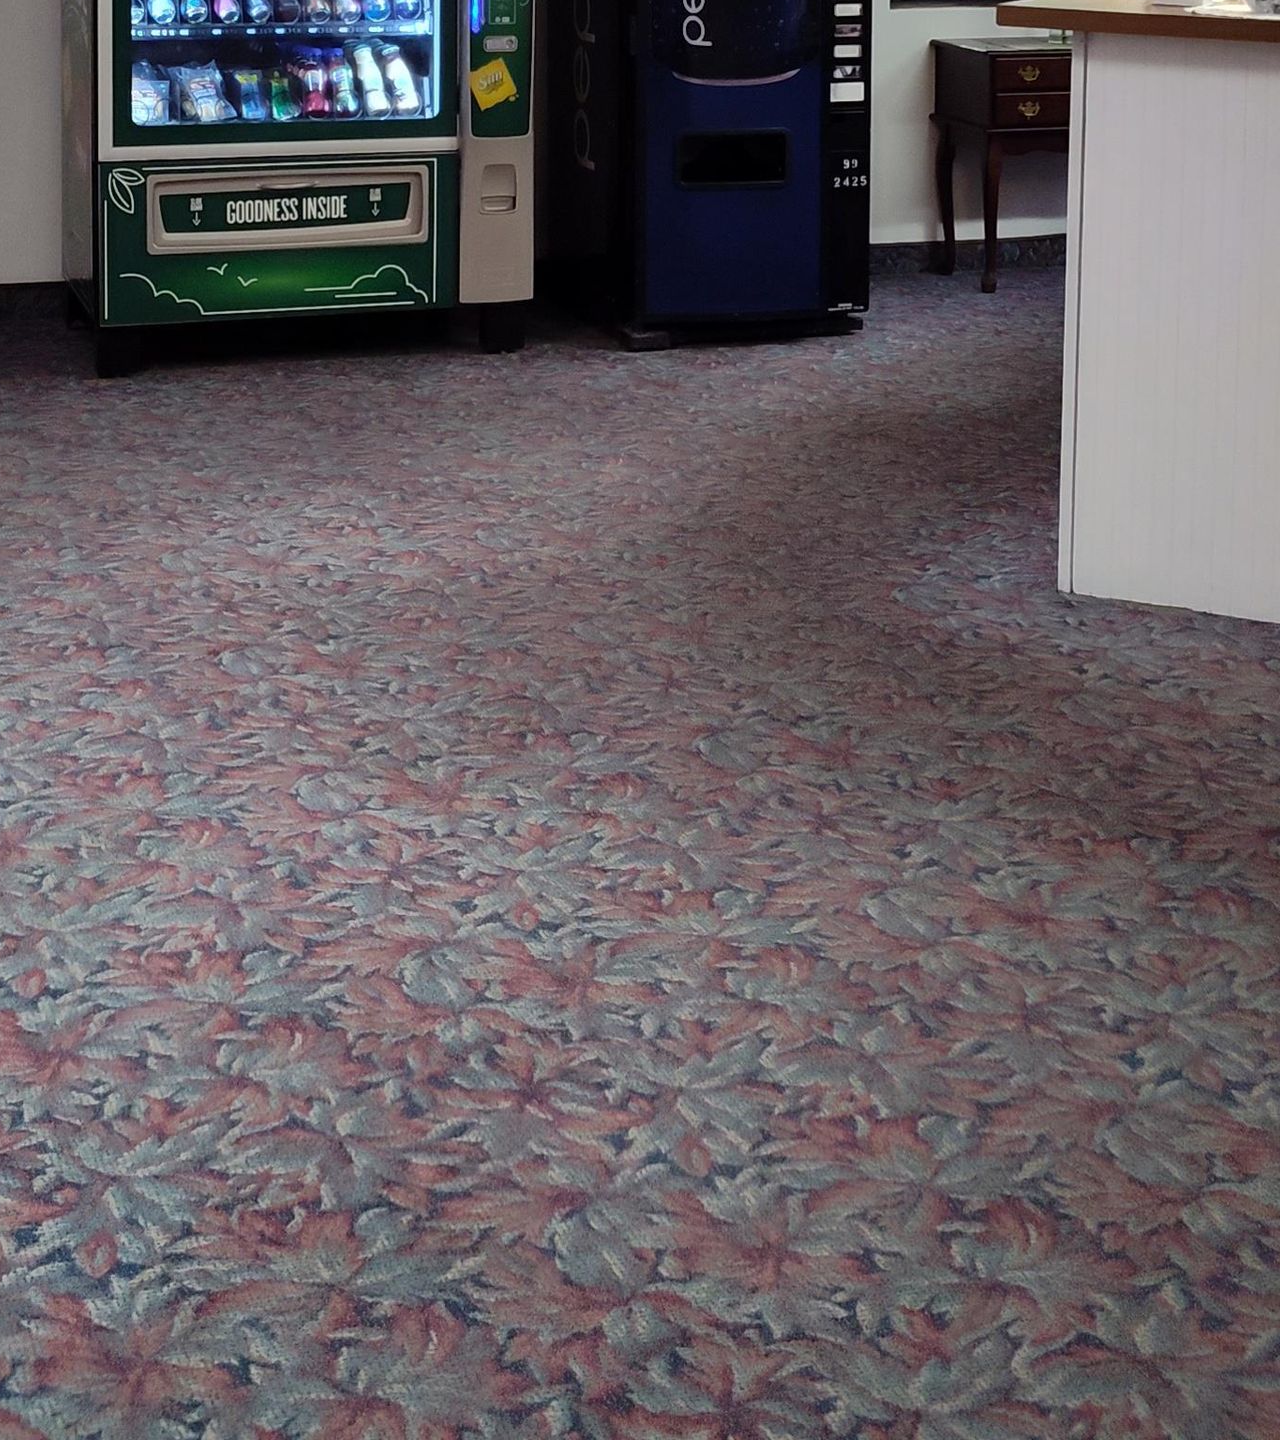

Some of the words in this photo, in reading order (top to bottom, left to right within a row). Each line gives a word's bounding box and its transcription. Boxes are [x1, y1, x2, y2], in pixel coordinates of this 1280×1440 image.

[843, 158, 858, 169] 99
[833, 175, 868, 188] 2425
[226, 197, 298, 225] GOODNESS
[302, 195, 348, 220] INSIDE
